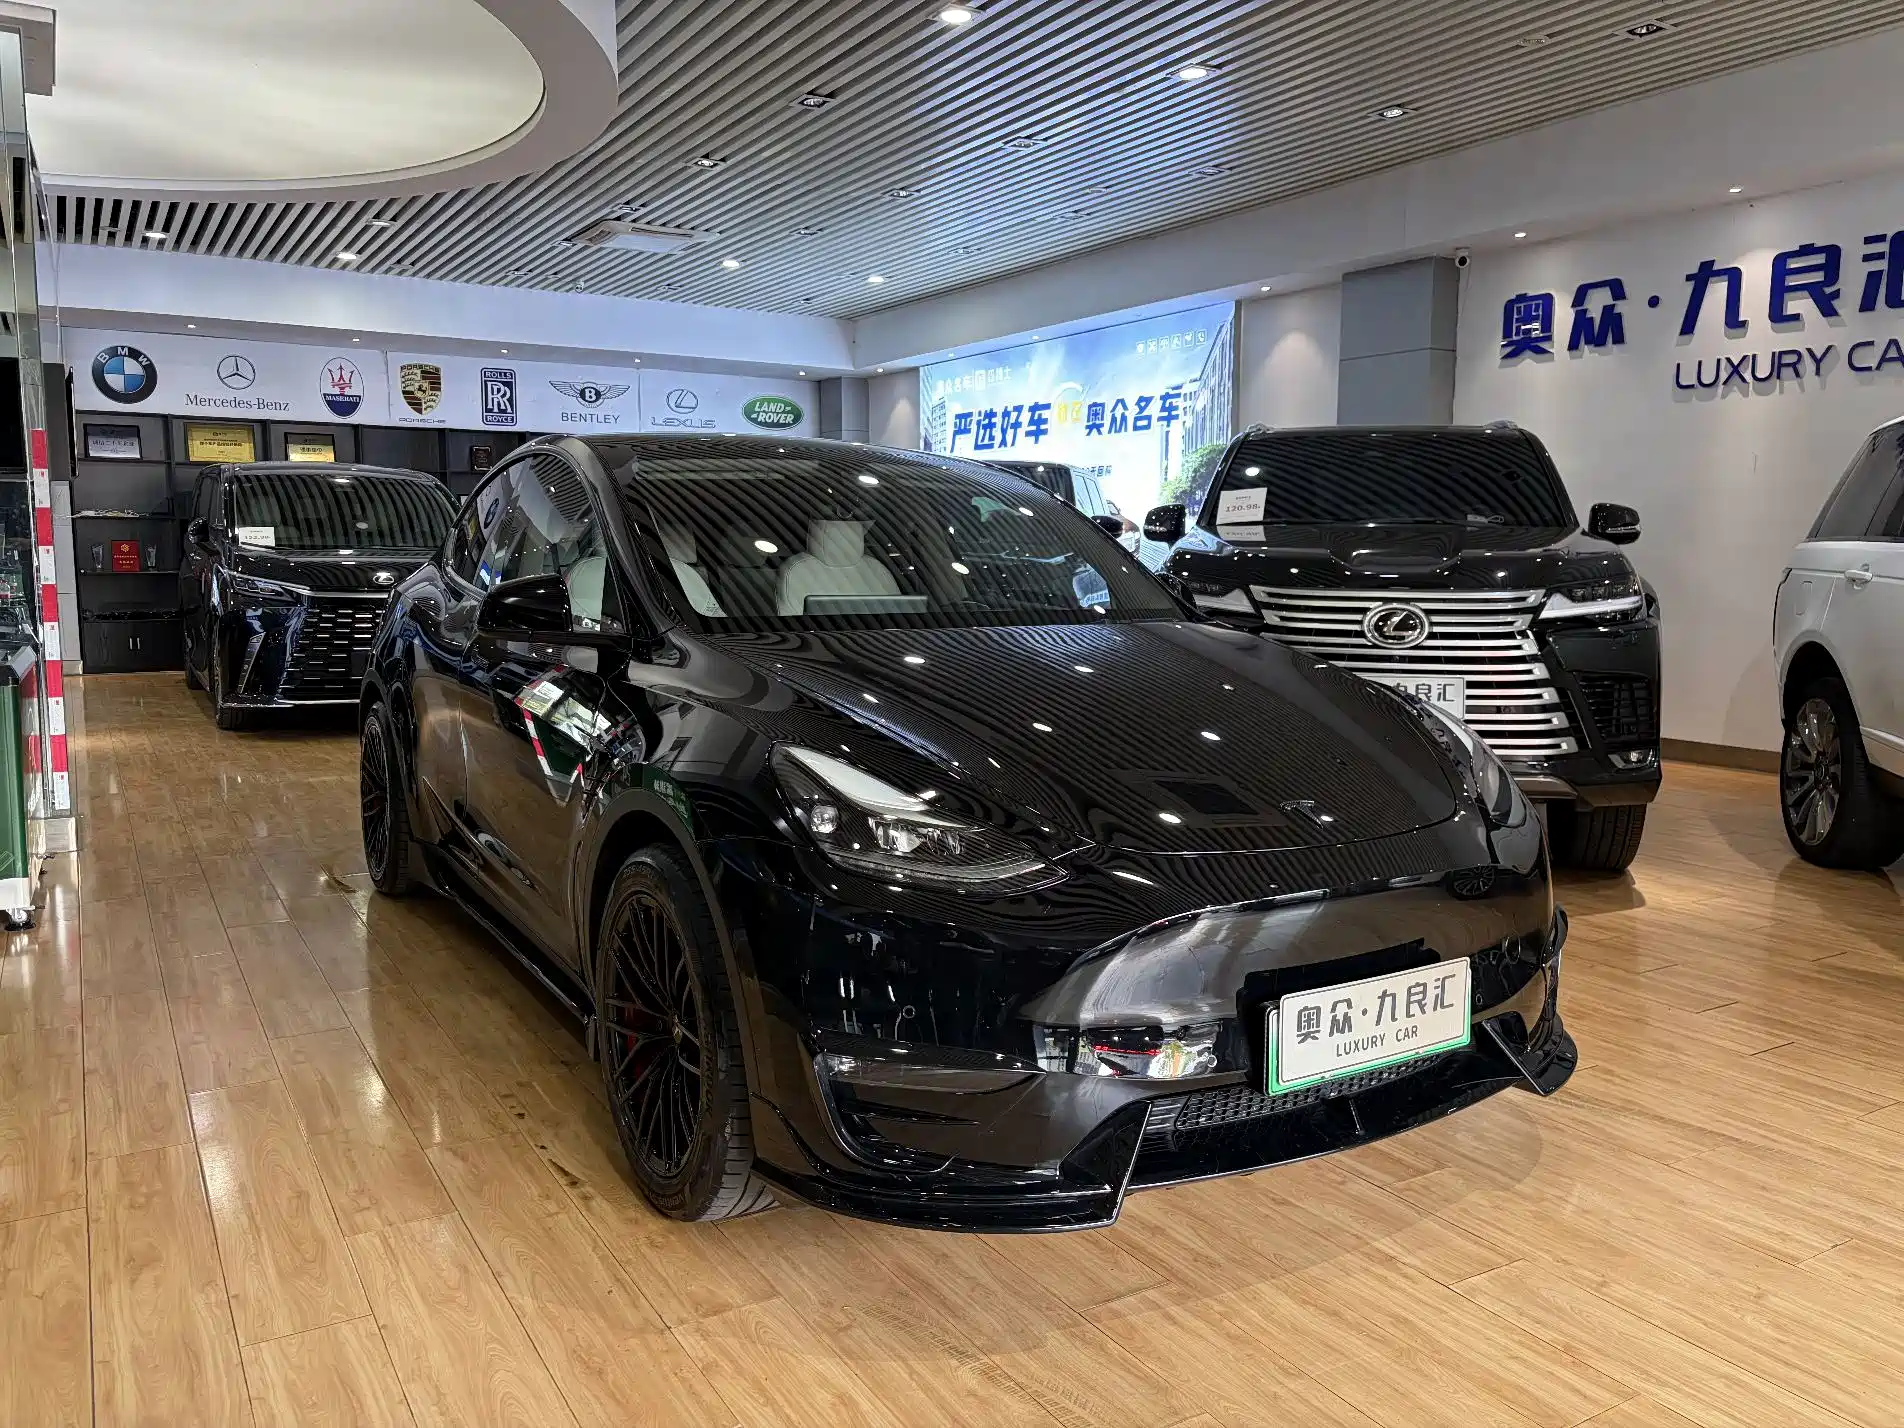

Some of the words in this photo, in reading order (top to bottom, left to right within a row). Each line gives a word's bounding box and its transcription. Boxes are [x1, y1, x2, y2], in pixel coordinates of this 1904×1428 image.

[96, 346, 151, 366] BMW
[400, 363, 442, 373] PORSCHE
[1675, 345, 1833, 390] LUXURY
[485, 370, 512, 379] ROLLS
[184, 394, 290, 412] Mercedes-Benz
[325, 394, 360, 403] MASERATI
[754, 401, 785, 413] LAND
[486, 415, 513, 424] ROYCE
[561, 412, 620, 424] BENTLEY
[651, 417, 716, 429] LEXUS
[758, 413, 795, 424] ROVER
[950, 402, 1051, 453] 严选好车
[1085, 391, 1182, 436] 奥众名车
[1296, 973, 1456, 1044] 奥众·九良汇
[1336, 1033, 1386, 1057] LUXURY
[1395, 1025, 1419, 1042] CAR
